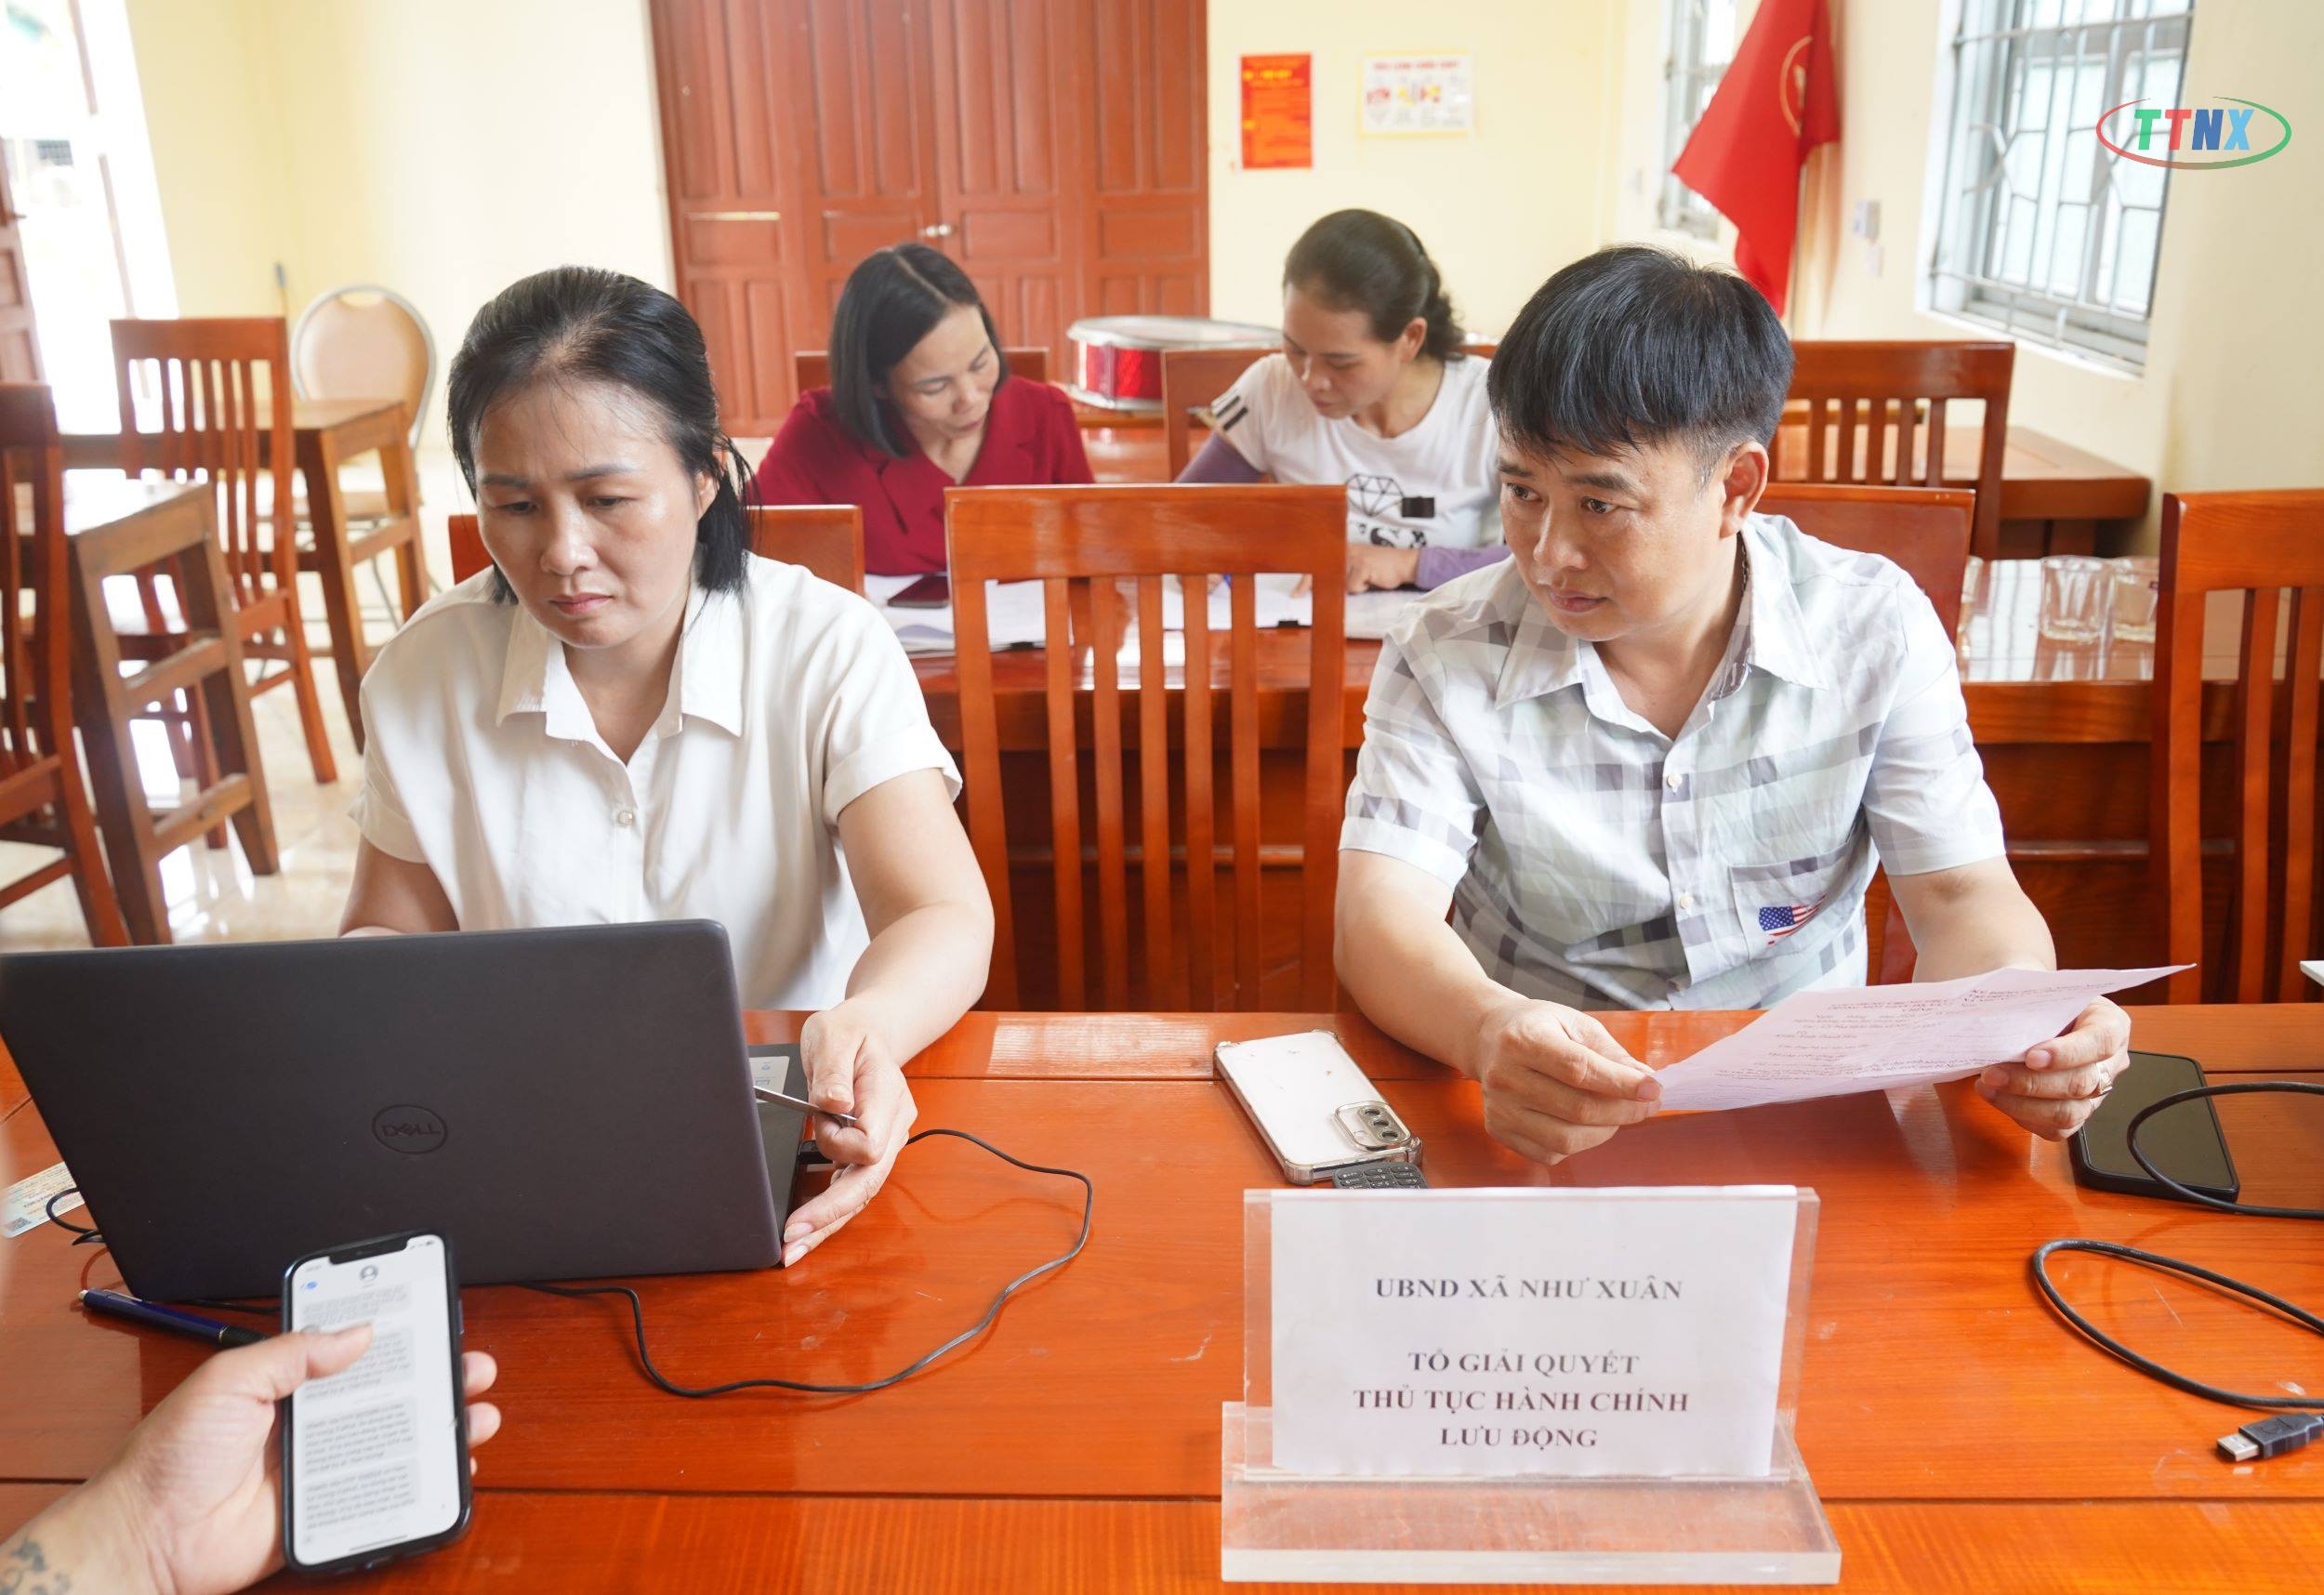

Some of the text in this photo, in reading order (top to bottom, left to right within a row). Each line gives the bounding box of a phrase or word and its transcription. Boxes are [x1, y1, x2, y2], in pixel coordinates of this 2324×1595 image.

[381, 1123, 442, 1138] DELL
[1376, 1274, 1683, 1299] UBND XÃ NHƯ XUÂN
[1407, 1348, 1640, 1378] TỔ GIẢI QUYẾT
[1353, 1384, 1689, 1415] THỦ TỤC HÀNH CHÍNH
[1441, 1425, 1598, 1451] LƯU ĐỘNG
